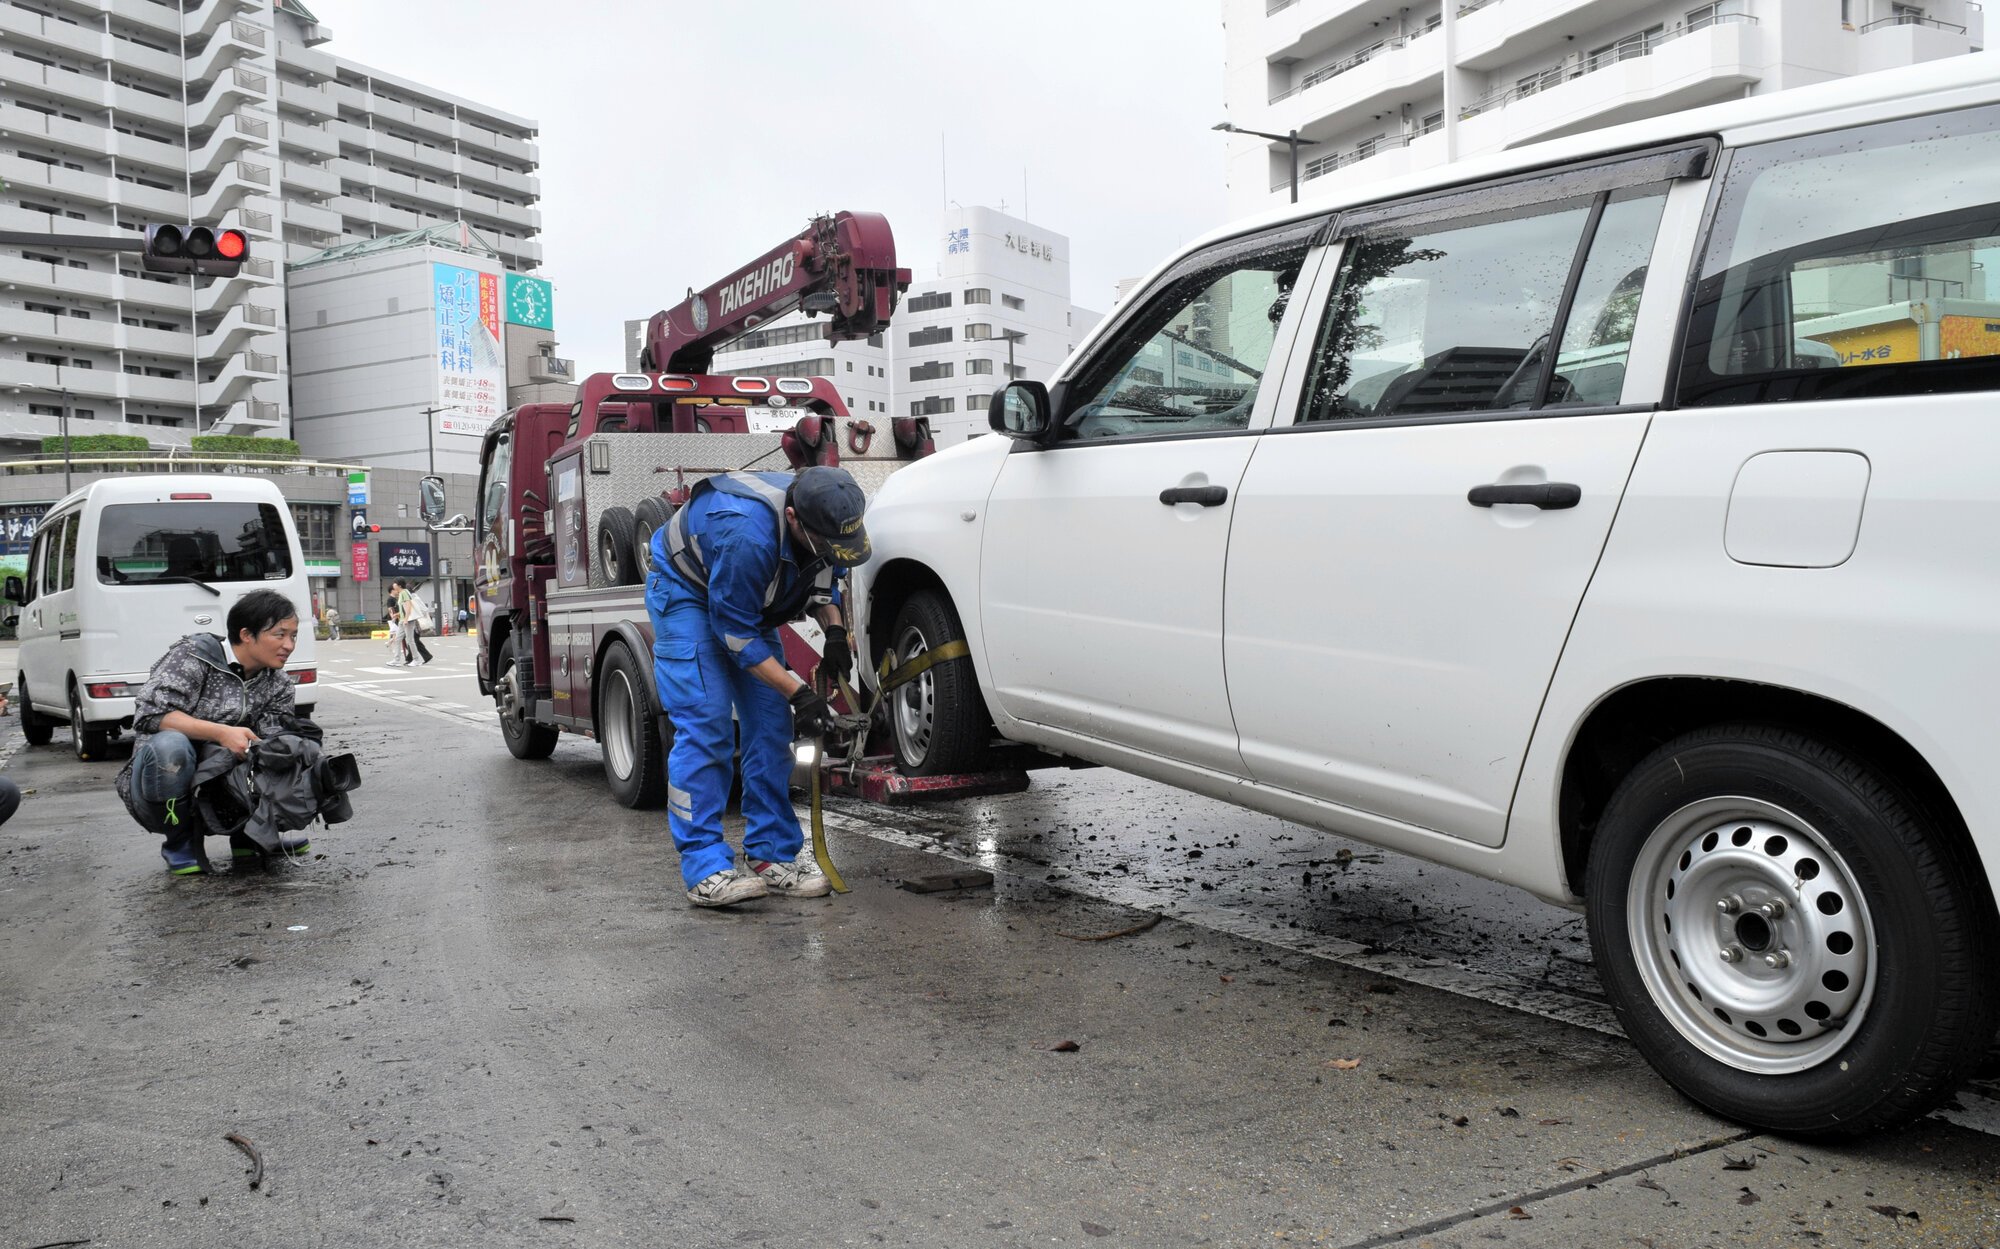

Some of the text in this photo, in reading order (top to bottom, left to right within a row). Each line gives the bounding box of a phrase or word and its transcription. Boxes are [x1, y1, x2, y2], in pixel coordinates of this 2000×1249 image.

[949, 228, 968, 241] 大隈
[949, 243, 969, 255] 病院
[480, 276, 489, 327] 徒歩3分
[720, 252, 794, 317] TAKEHIRO
[440, 284, 456, 372] 矯正歯科
[456, 272, 473, 374] ルーセント歯科
[779, 410, 794, 418] 800
